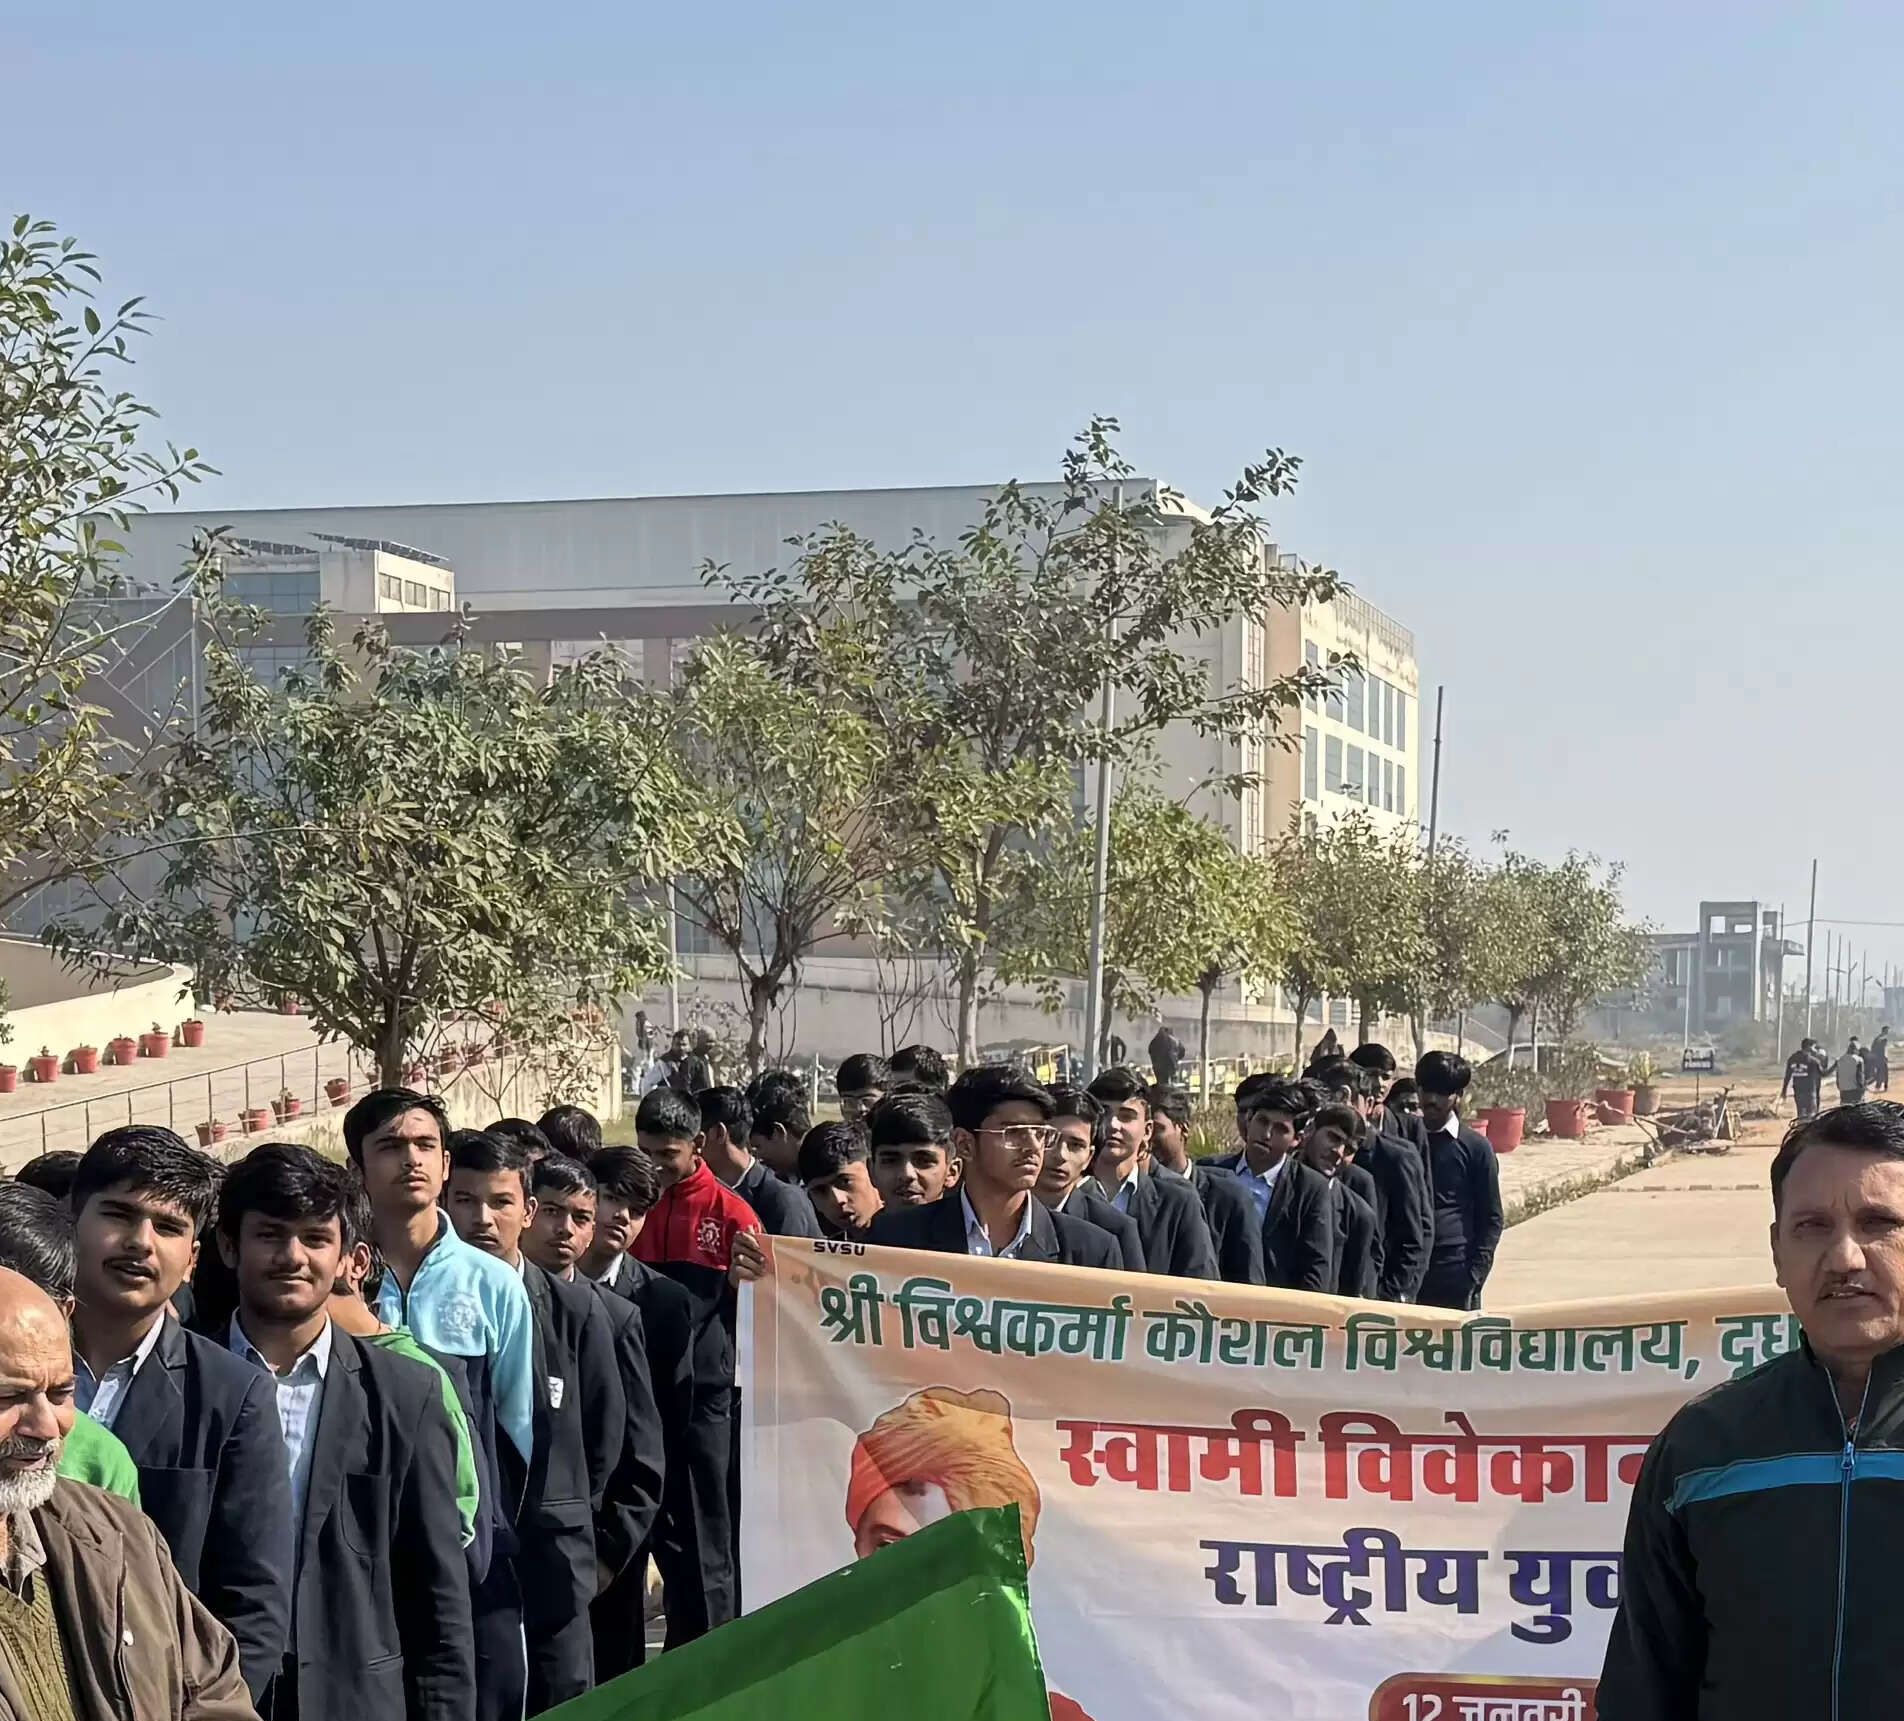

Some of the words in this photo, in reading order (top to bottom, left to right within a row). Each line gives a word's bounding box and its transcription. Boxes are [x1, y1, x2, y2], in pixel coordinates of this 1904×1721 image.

[814, 1241, 865, 1256] SVSU
[820, 1274, 885, 1346] श्री
[893, 1276, 1134, 1361] विश्वकर्मा
[1142, 1300, 1330, 1369] कौशल
[1339, 1313, 1700, 1380] विश्वविद्यालय,
[1056, 1408, 1306, 1498] स्वामी
[1199, 1527, 1489, 1627] राष्ट्रीय
[1503, 1551, 1624, 1645] युव
